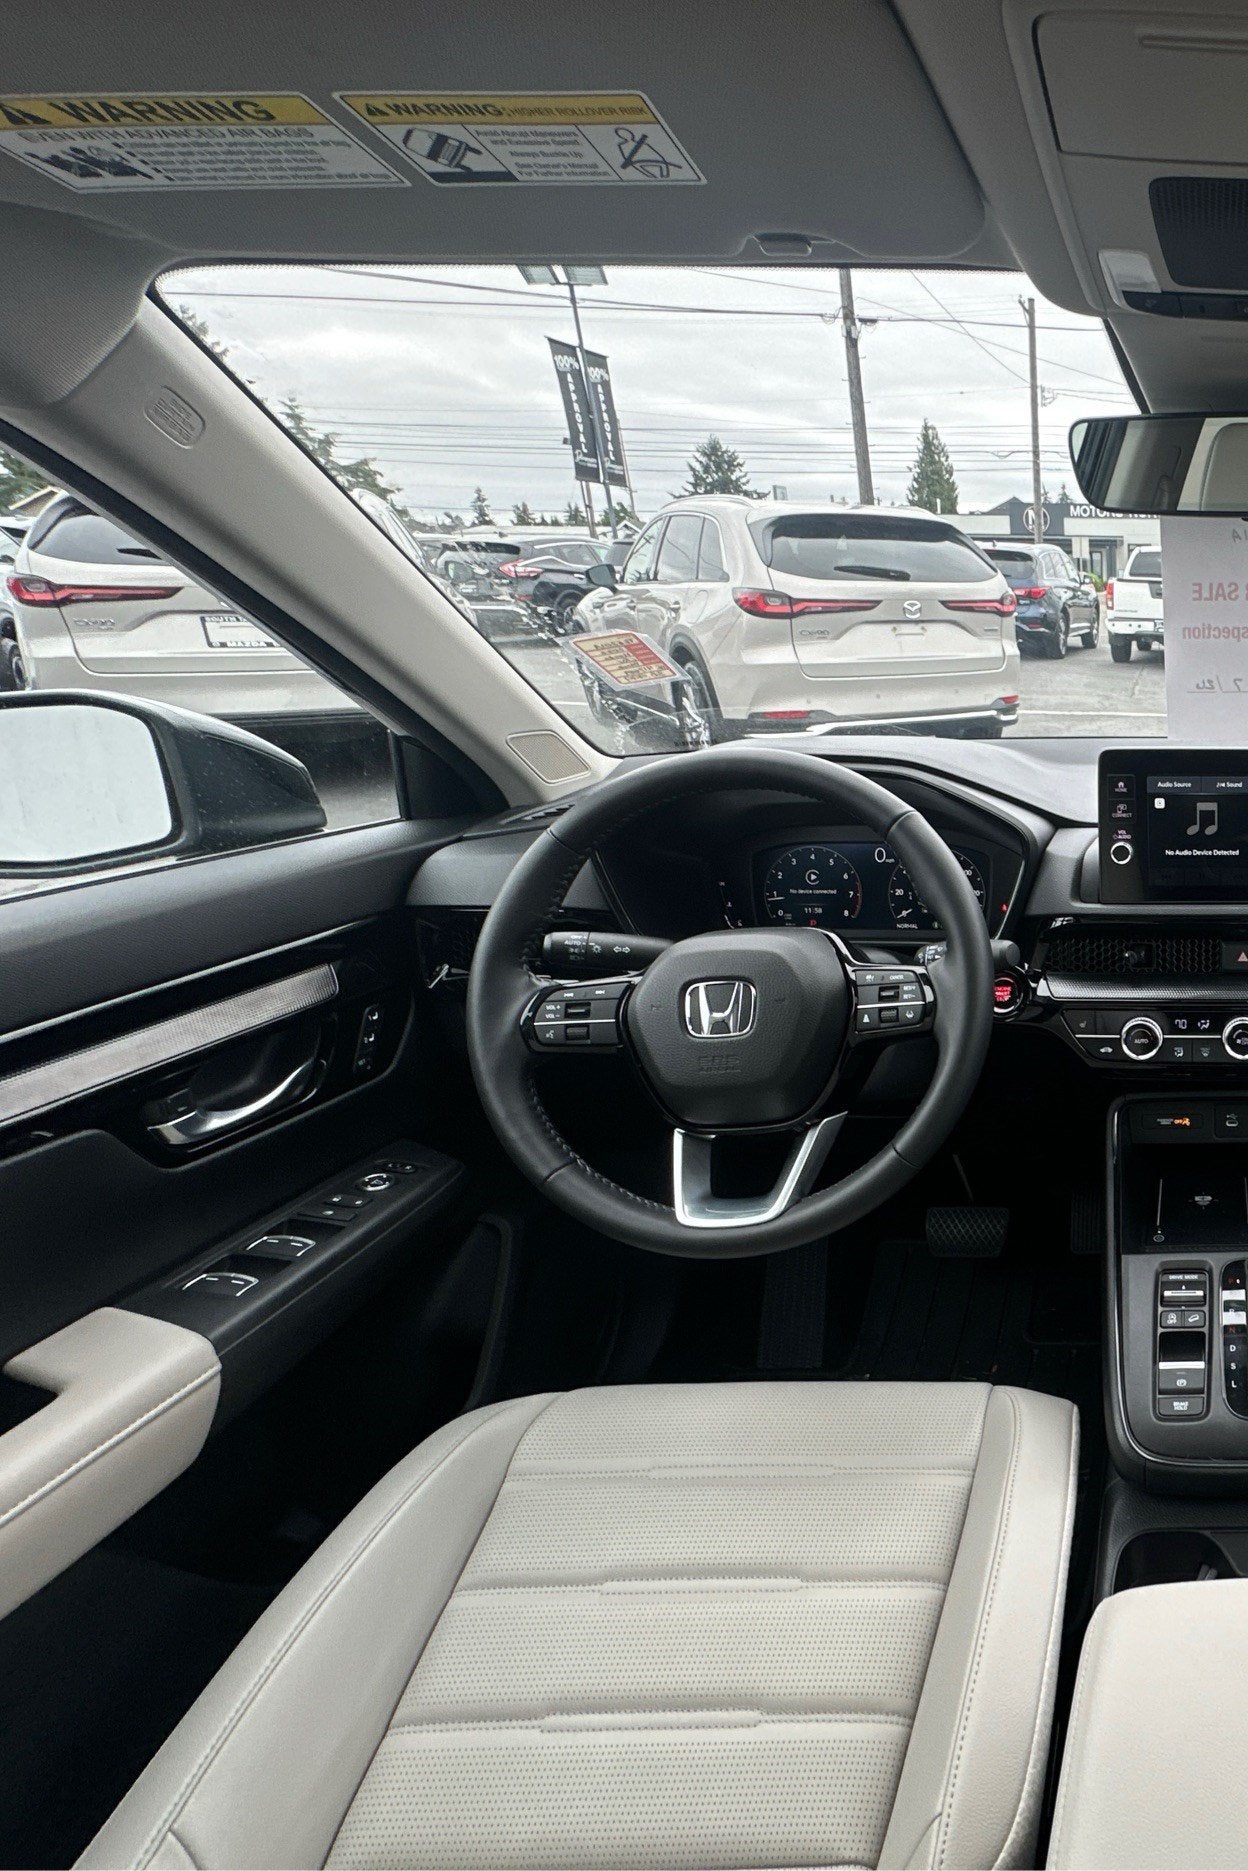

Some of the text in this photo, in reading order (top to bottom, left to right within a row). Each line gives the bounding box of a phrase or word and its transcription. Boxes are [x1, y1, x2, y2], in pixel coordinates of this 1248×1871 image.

[47, 100, 277, 123] WARNING
[509, 106, 554, 116] HIGHER
[554, 106, 617, 116] ROLLOVER
[617, 106, 648, 116] RISK
[124, 128, 226, 140] ADVANCED
[226, 127, 263, 139] AIR
[259, 127, 315, 138] BAGS
[554, 354, 579, 372] 100%
[587, 366, 609, 383] 100%
[567, 372, 588, 453] APPROVAL
[597, 383, 616, 461] APPROVAL
[226, 640, 267, 648] MAZDA
[810, 853, 815, 861] 4
[875, 847, 886, 863] 0
[777, 871, 783, 879] 2
[843, 872, 849, 880] 6
[849, 891, 854, 899] 7
[895, 888, 904, 896] 20
[777, 909, 784, 917] 0
[843, 909, 849, 917] 8
[1229, 1344, 1236, 1352] D
[1230, 1362, 1237, 1370] S
[1231, 1380, 1237, 1388] L
